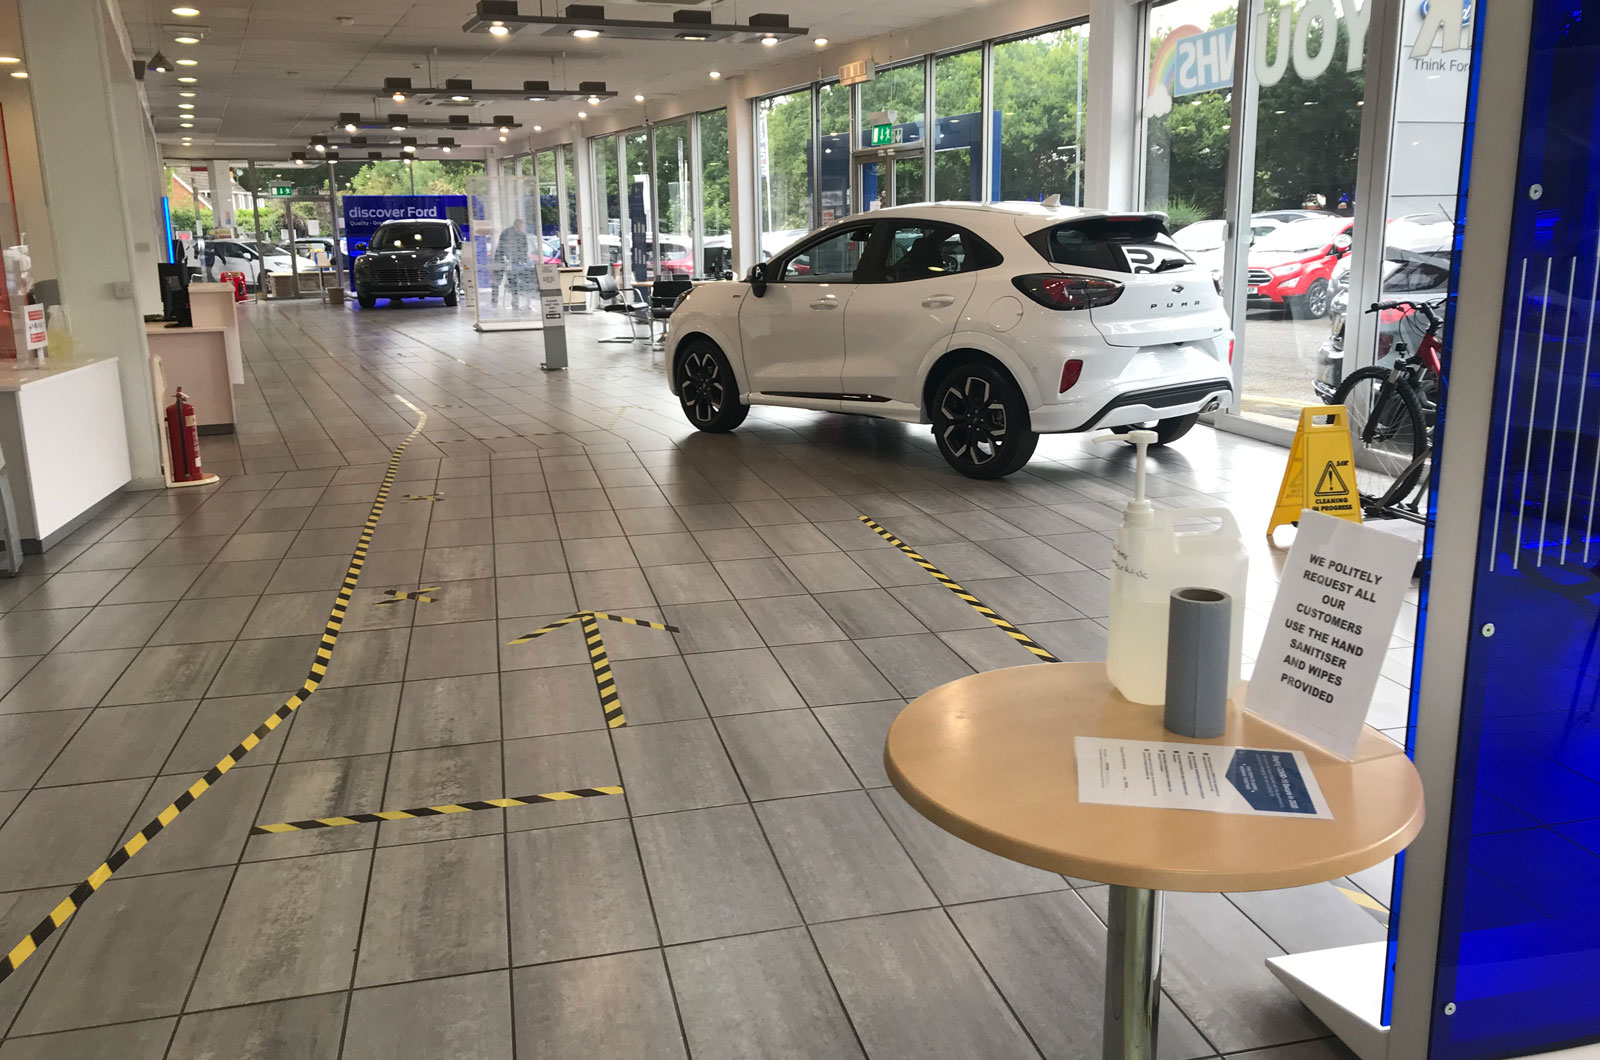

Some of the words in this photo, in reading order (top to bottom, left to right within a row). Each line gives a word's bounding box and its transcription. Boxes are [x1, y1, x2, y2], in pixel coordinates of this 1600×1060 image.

[1413, 58, 1446, 71] Think
[1450, 59, 1470, 72] For
[349, 207, 405, 218] discover
[407, 206, 437, 218] Ford
[1150, 300, 1200, 309] PUMA
[1309, 554, 1326, 567] WE
[1328, 560, 1383, 585] POLITELY
[1303, 570, 1353, 594] REQUEST
[1354, 588, 1376, 603] ALL
[1322, 594, 1346, 610] OUR
[1296, 603, 1363, 635] CUSTOMERS
[1285, 618, 1306, 633] USE
[1308, 627, 1330, 643] THE
[1331, 637, 1363, 657] HAND
[1289, 639, 1347, 669] SANITISER
[1283, 655, 1306, 670] AND
[1308, 664, 1342, 686] WIPES
[1280, 673, 1334, 704] PROVIDED
